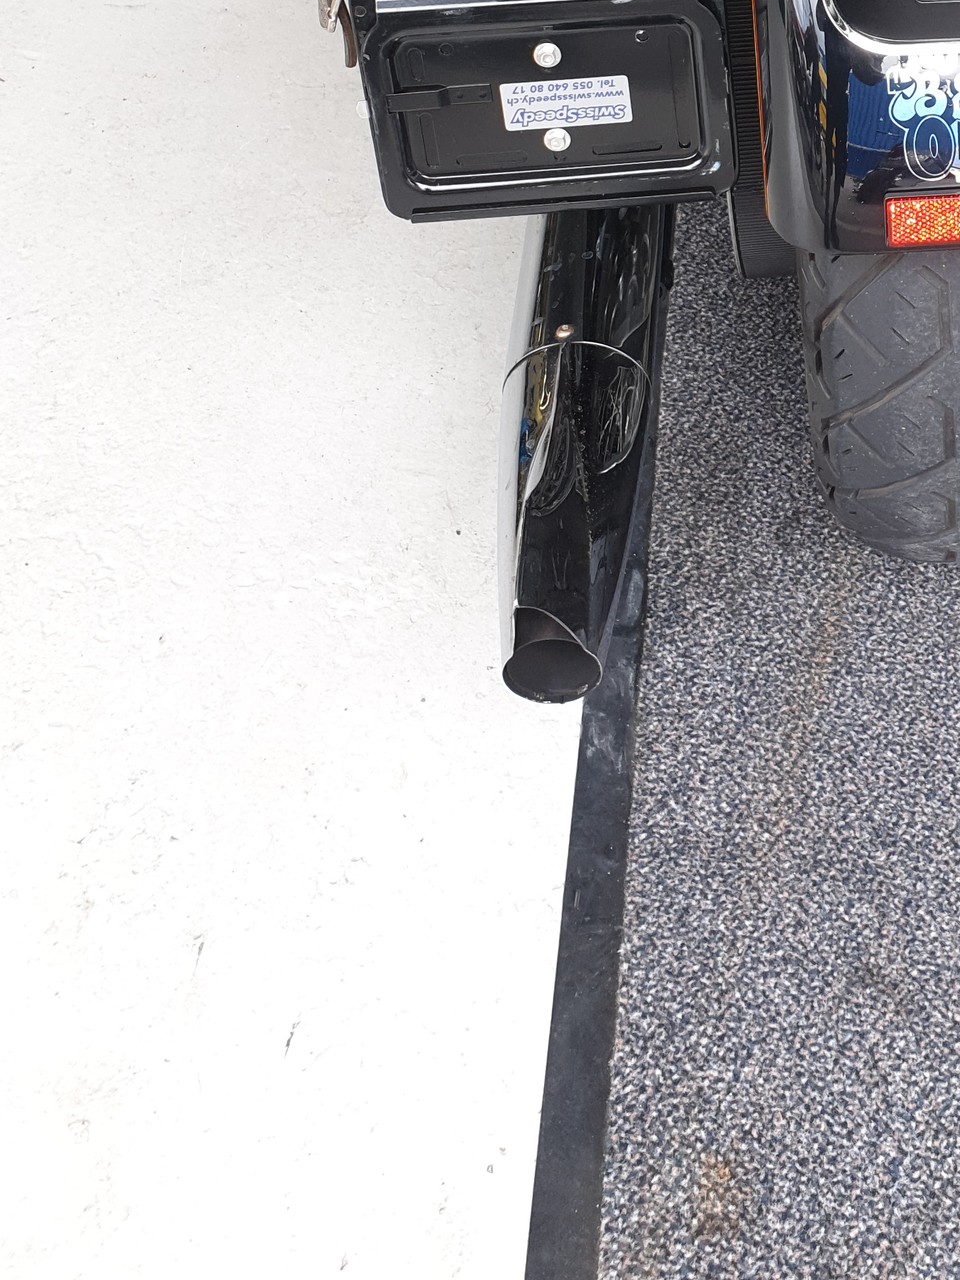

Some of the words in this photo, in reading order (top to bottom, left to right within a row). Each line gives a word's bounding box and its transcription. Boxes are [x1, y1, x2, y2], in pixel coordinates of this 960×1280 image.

[547, 82, 569, 92] 640
[572, 81, 594, 90] 055
[597, 79, 616, 88] Tel.
[512, 86, 526, 95] 17
[529, 84, 544, 94] 80
[507, 90, 624, 107] www.swissspeedy.ch
[510, 104, 627, 127] SwissSpeedy
